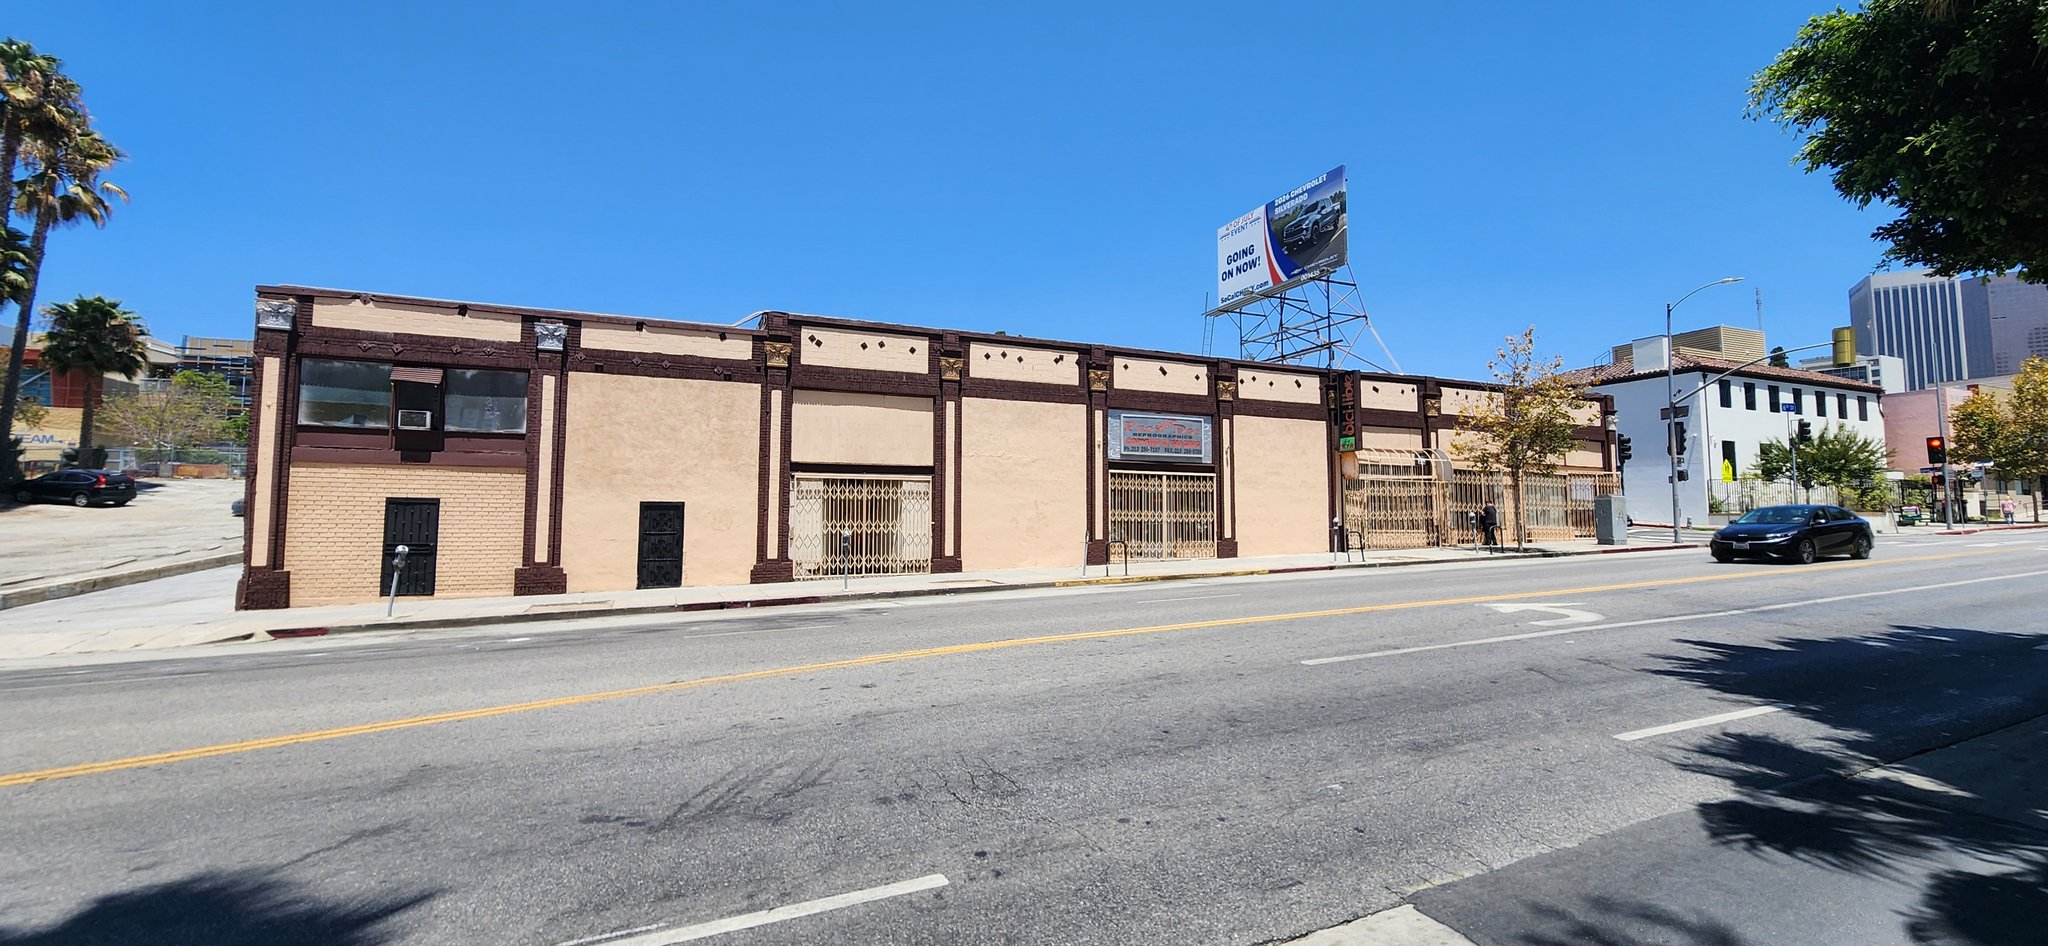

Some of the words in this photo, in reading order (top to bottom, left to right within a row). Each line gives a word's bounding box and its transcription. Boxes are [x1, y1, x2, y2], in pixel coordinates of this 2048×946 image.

[1290, 174, 1327, 197] CHEVROLET
[1274, 193, 1308, 214] SILVERADO
[1241, 211, 1255, 224] JULY
[1230, 222, 1249, 236] EVENT
[1226, 244, 1255, 265] GOING
[1221, 268, 1234, 281] ON
[1235, 256, 1261, 277] NOW!
[1220, 280, 1269, 304] SoCalCHY.com
[1132, 432, 1193, 440] REPROGRAPHICS
